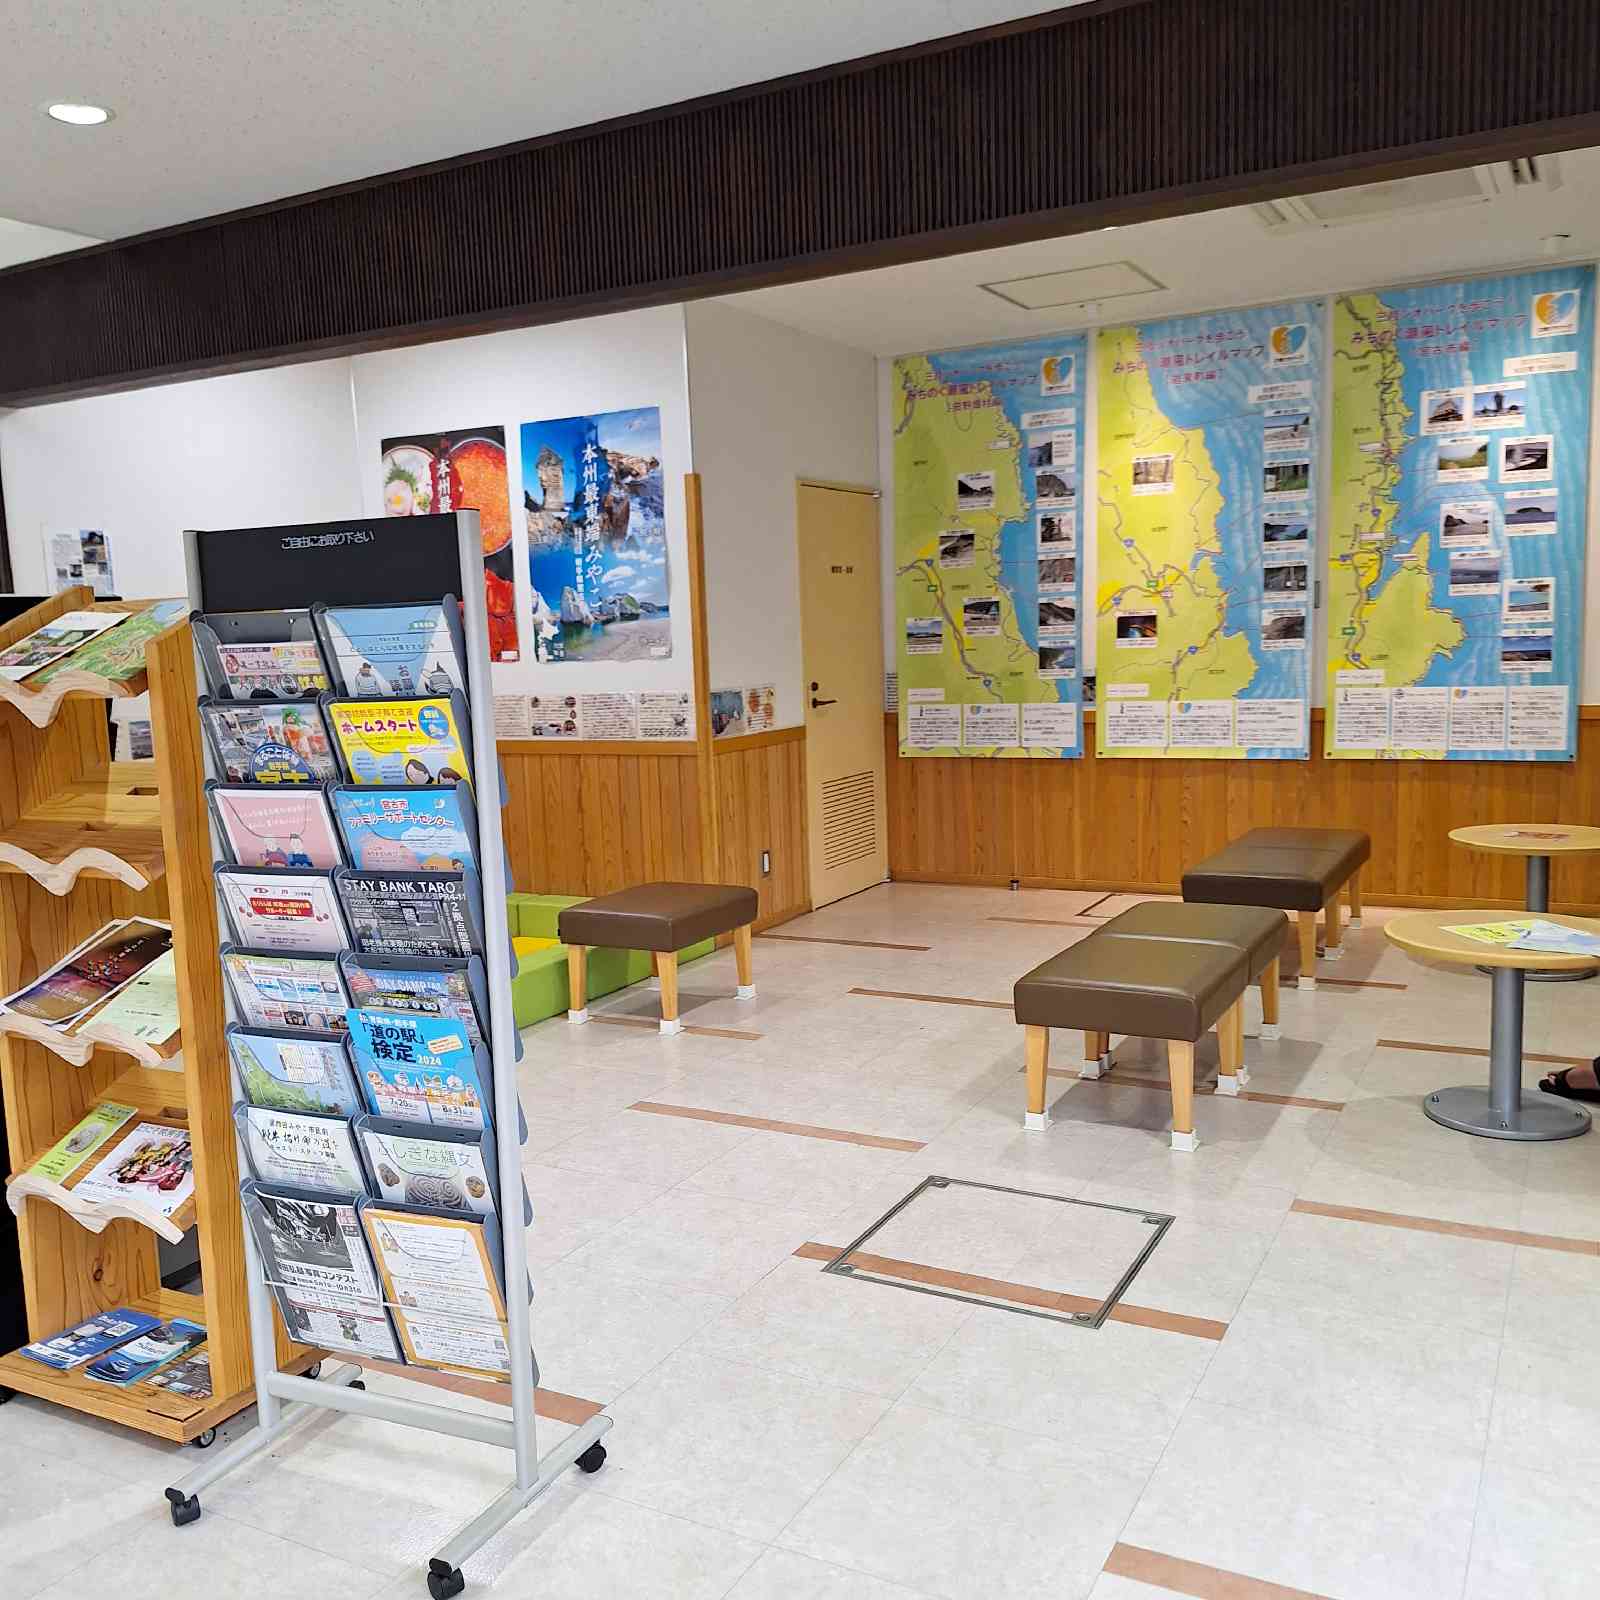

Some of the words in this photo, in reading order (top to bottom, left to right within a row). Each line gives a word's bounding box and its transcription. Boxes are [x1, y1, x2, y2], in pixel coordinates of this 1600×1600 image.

[281, 530, 375, 549] ご自由にお取り下さい
[341, 719, 417, 735] ホームスタート
[381, 799, 408, 811] 宮古市
[347, 811, 455, 829] ファミリーサポートセンター
[344, 879, 375, 891] STAY
[379, 881, 416, 893] BANK
[418, 881, 456, 894] TARO
[362, 1023, 425, 1045] 「道の駅」
[371, 1039, 417, 1063] 検定
[417, 1055, 443, 1066] 2024
